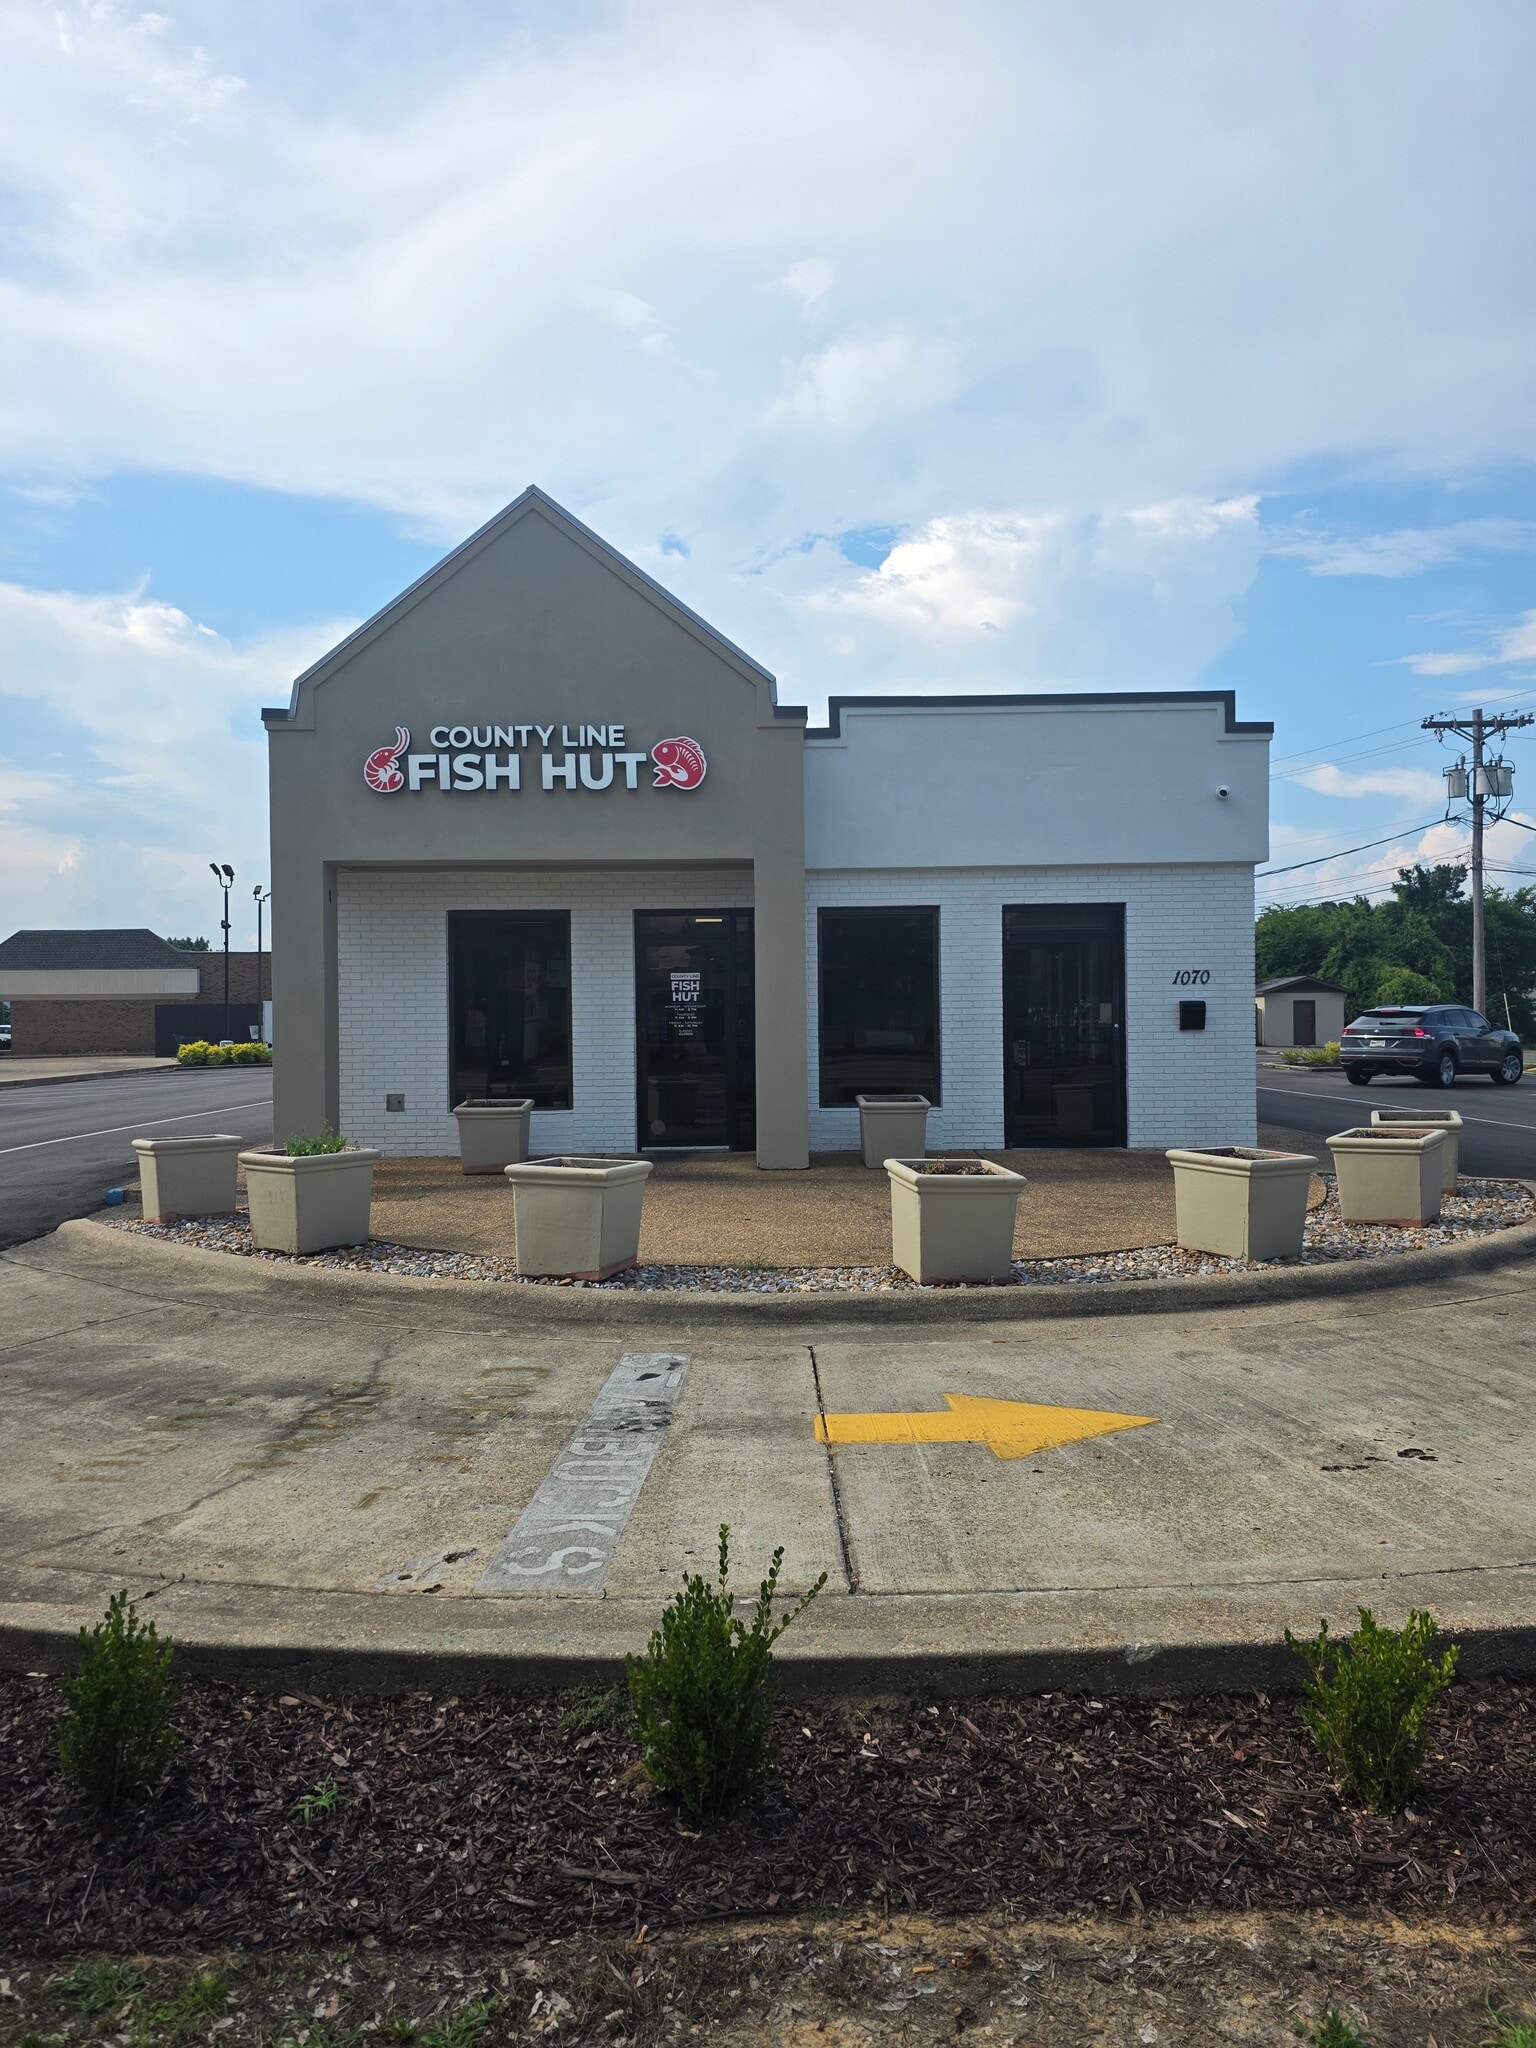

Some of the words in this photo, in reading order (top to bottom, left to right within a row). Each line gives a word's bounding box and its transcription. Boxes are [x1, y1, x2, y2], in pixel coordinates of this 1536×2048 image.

[430, 725, 555, 748] COUNTY
[562, 725, 626, 747] LINE
[407, 753, 521, 791] FISH
[541, 753, 648, 790] HUT
[671, 981, 699, 990] FISH
[1172, 969, 1211, 985] 1070
[672, 992, 699, 1001] HUT
[502, 1354, 689, 1575] SARBUCKS
